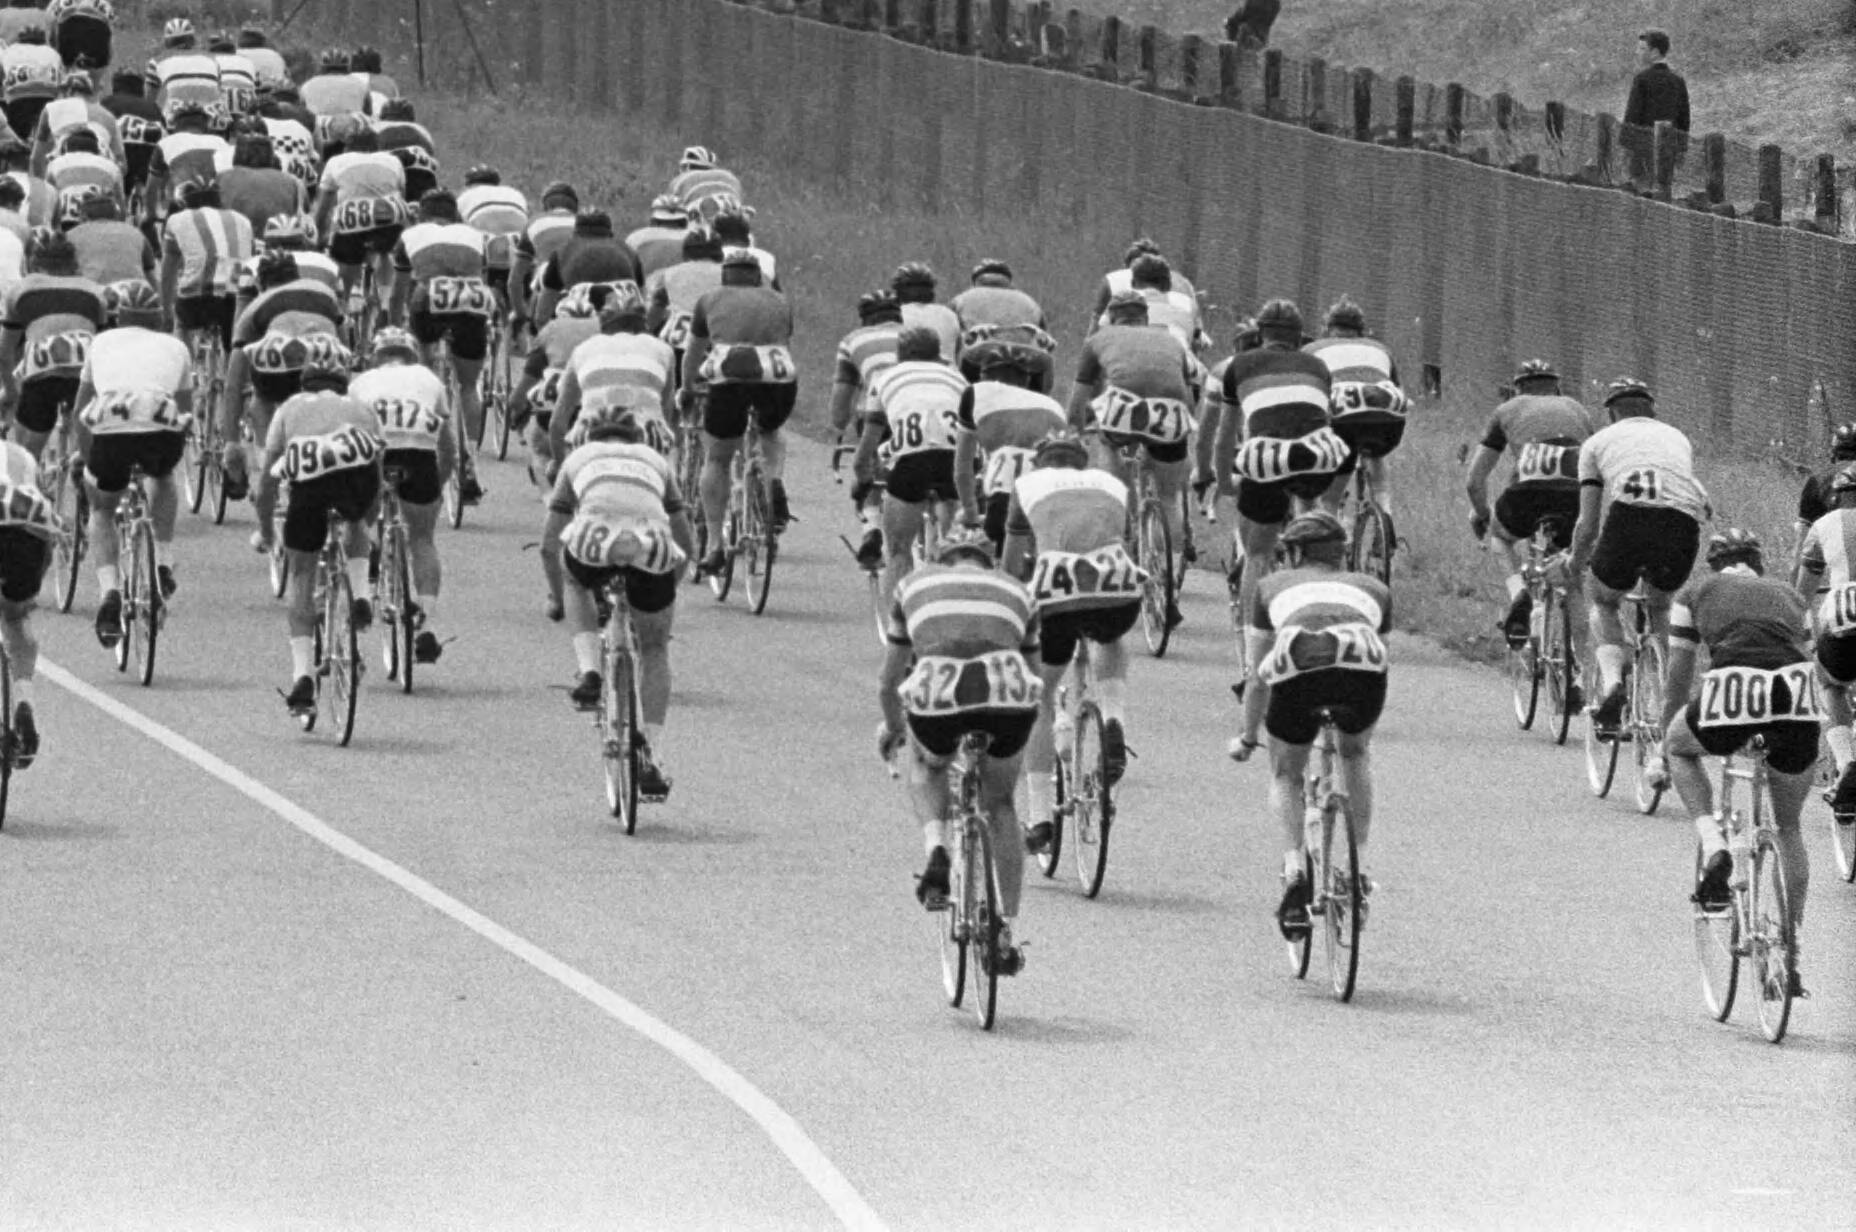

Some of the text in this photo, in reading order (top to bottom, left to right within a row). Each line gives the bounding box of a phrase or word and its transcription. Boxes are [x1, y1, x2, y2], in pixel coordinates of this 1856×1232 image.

[1623, 470, 1656, 501] 41
[913, 661, 957, 711] 32
[1704, 673, 1768, 719] 200
